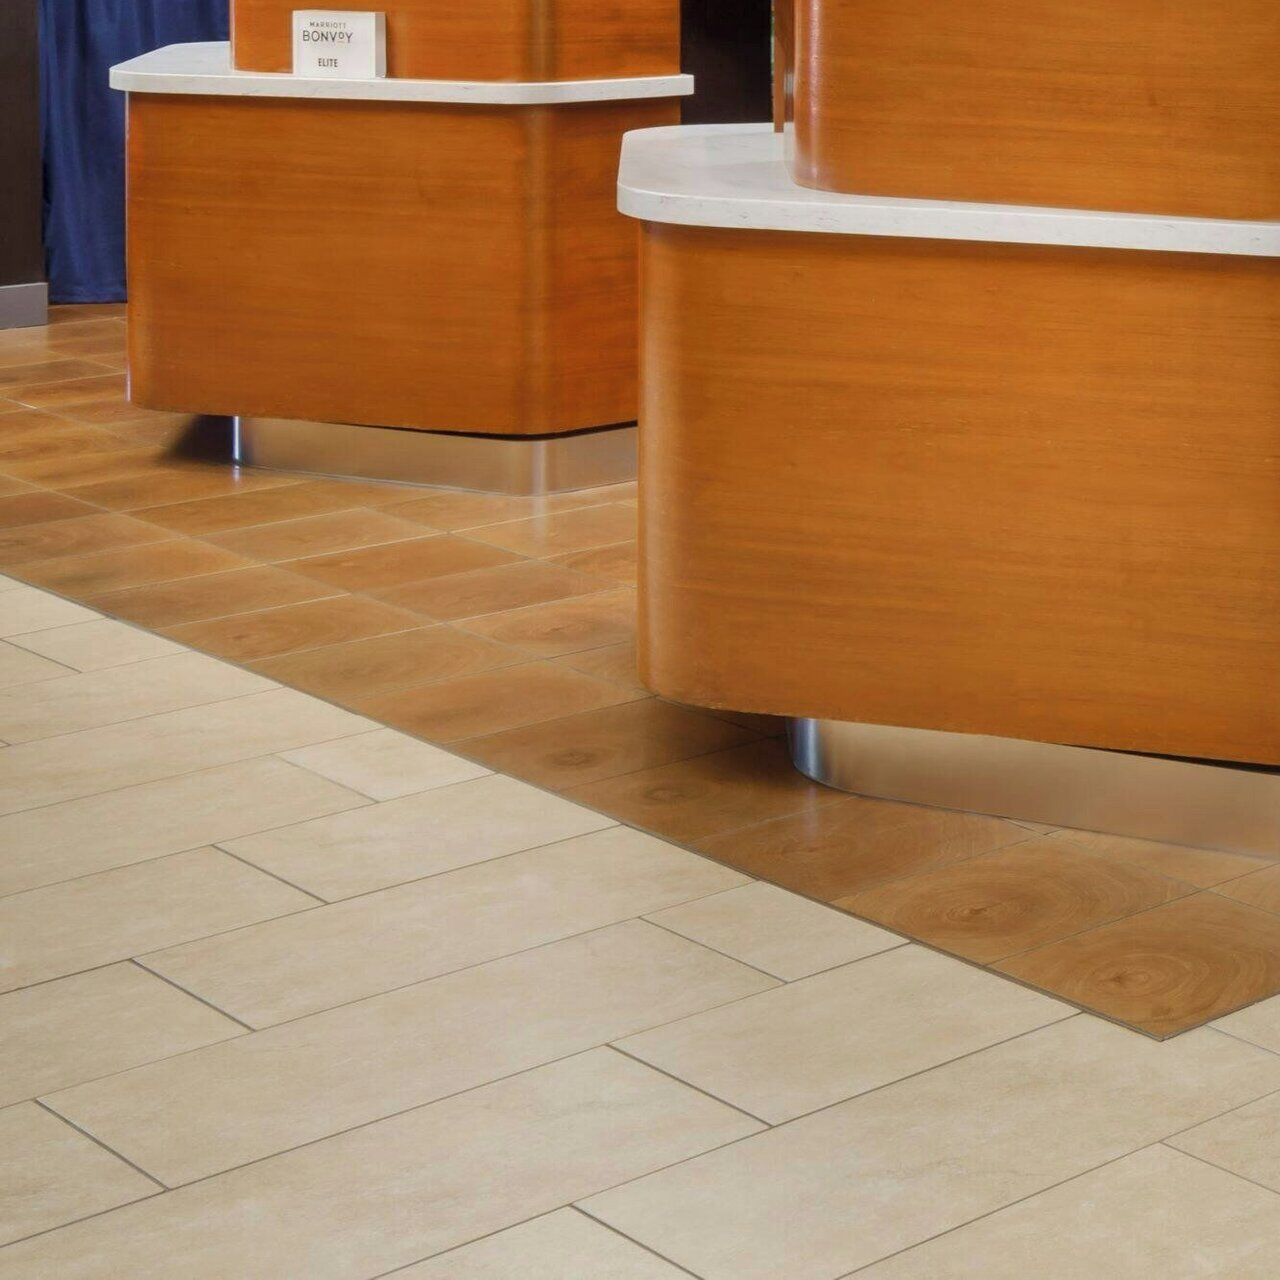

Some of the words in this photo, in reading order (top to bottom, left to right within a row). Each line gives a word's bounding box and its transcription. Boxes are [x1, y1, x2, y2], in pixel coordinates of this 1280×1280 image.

[309, 21, 347, 29] MARRIOTT
[302, 30, 353, 43] BONVOY
[318, 58, 338, 68] ELITE
